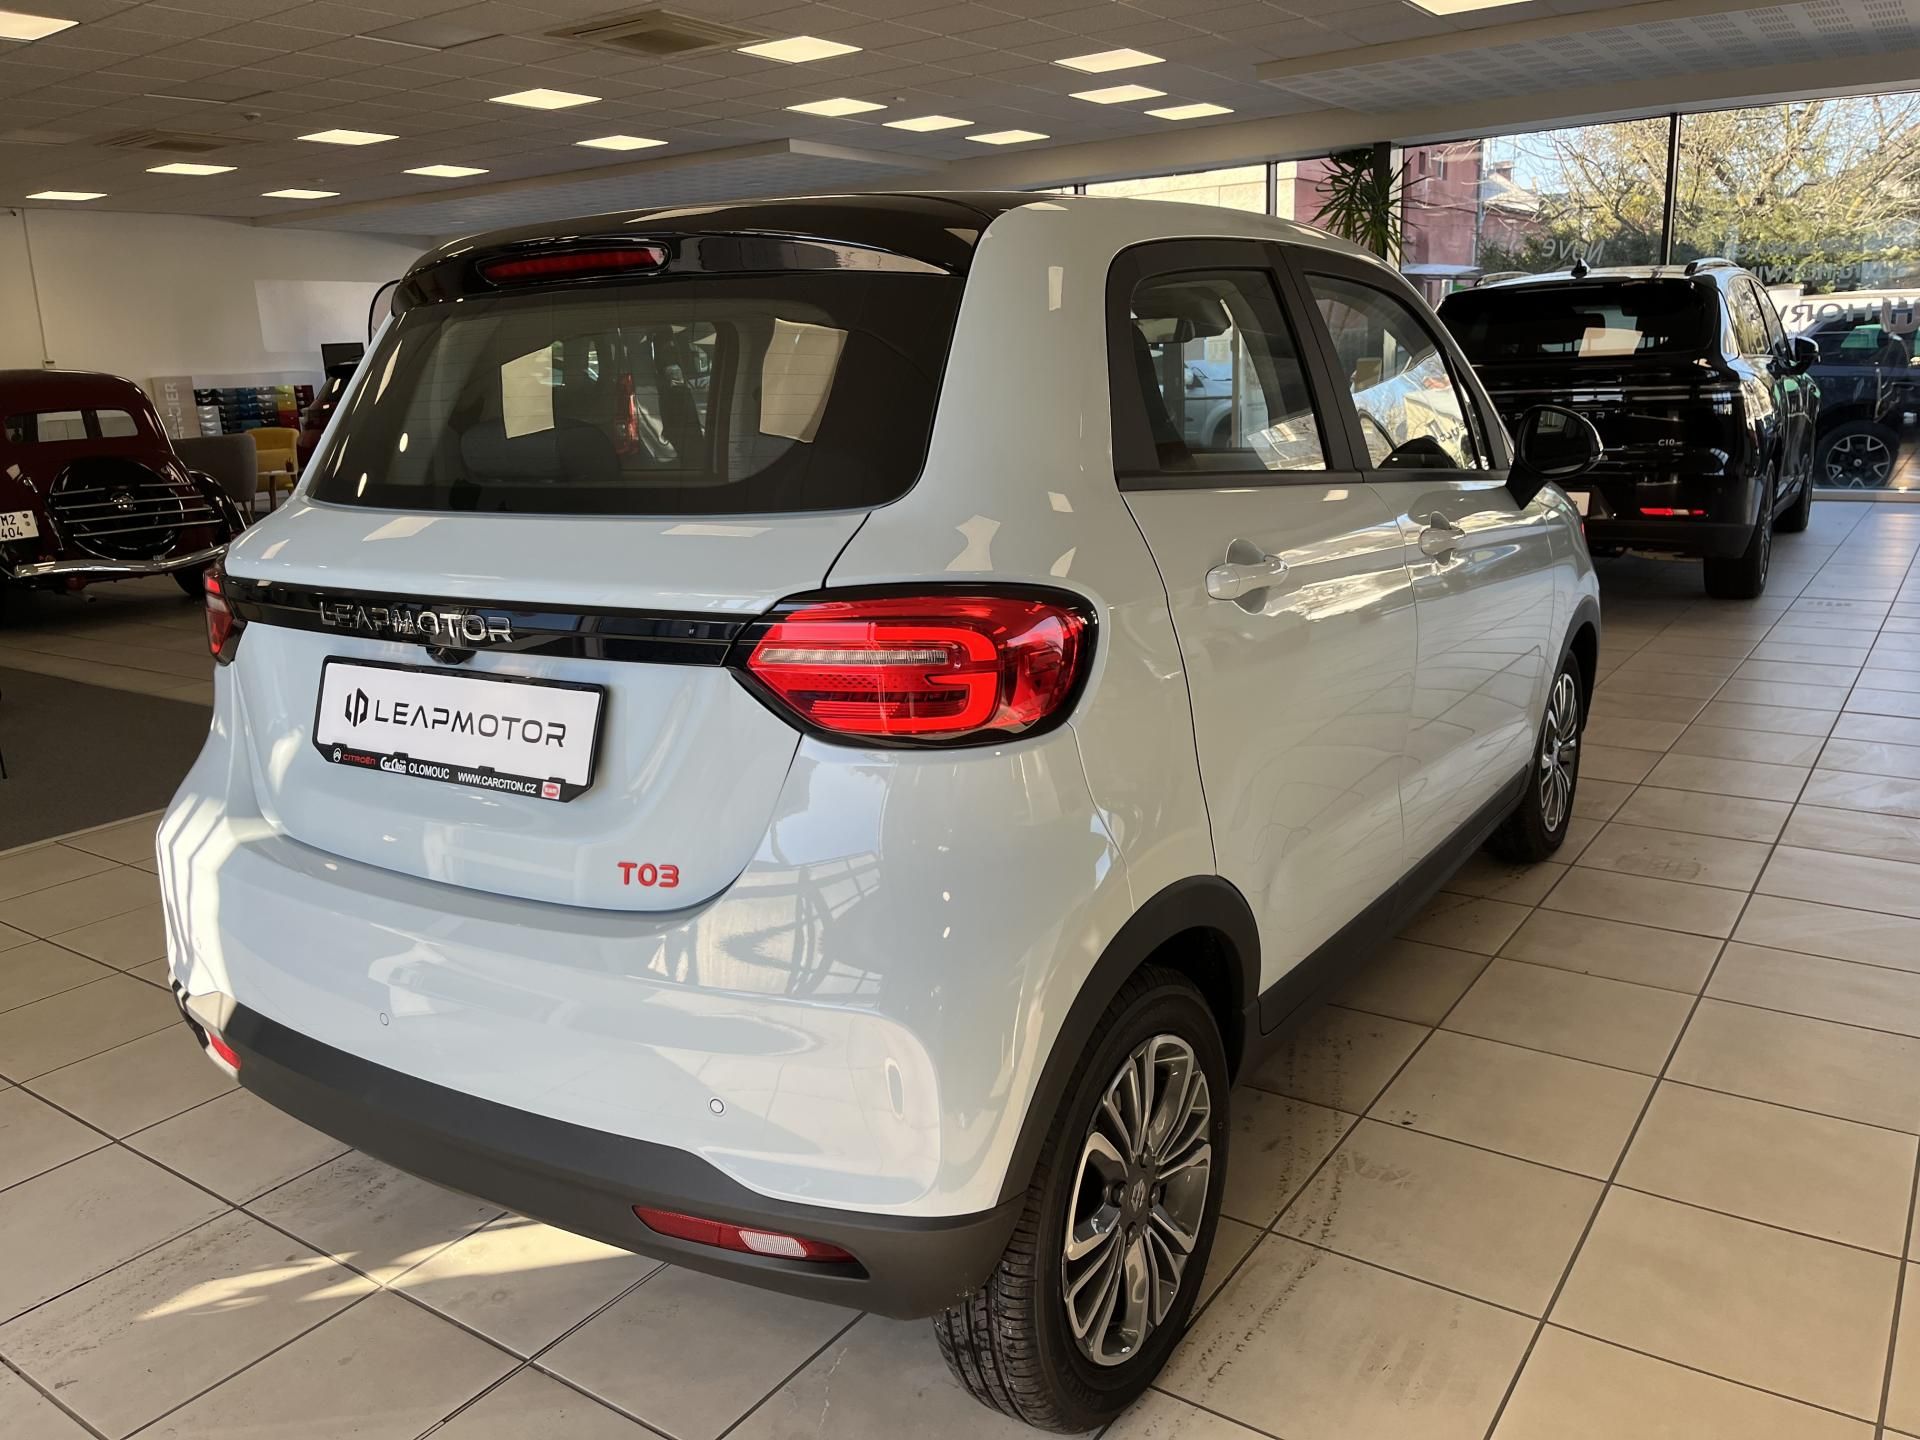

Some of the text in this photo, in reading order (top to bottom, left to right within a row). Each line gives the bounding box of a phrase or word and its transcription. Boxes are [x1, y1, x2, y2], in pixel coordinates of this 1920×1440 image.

[320, 600, 513, 643] LEAPMOTOR
[374, 700, 567, 748] LEAPMOTOR
[408, 763, 450, 780] OLOMOUC
[458, 772, 537, 794] WWW.CARCITON.CZ
[617, 862, 680, 888] T03
